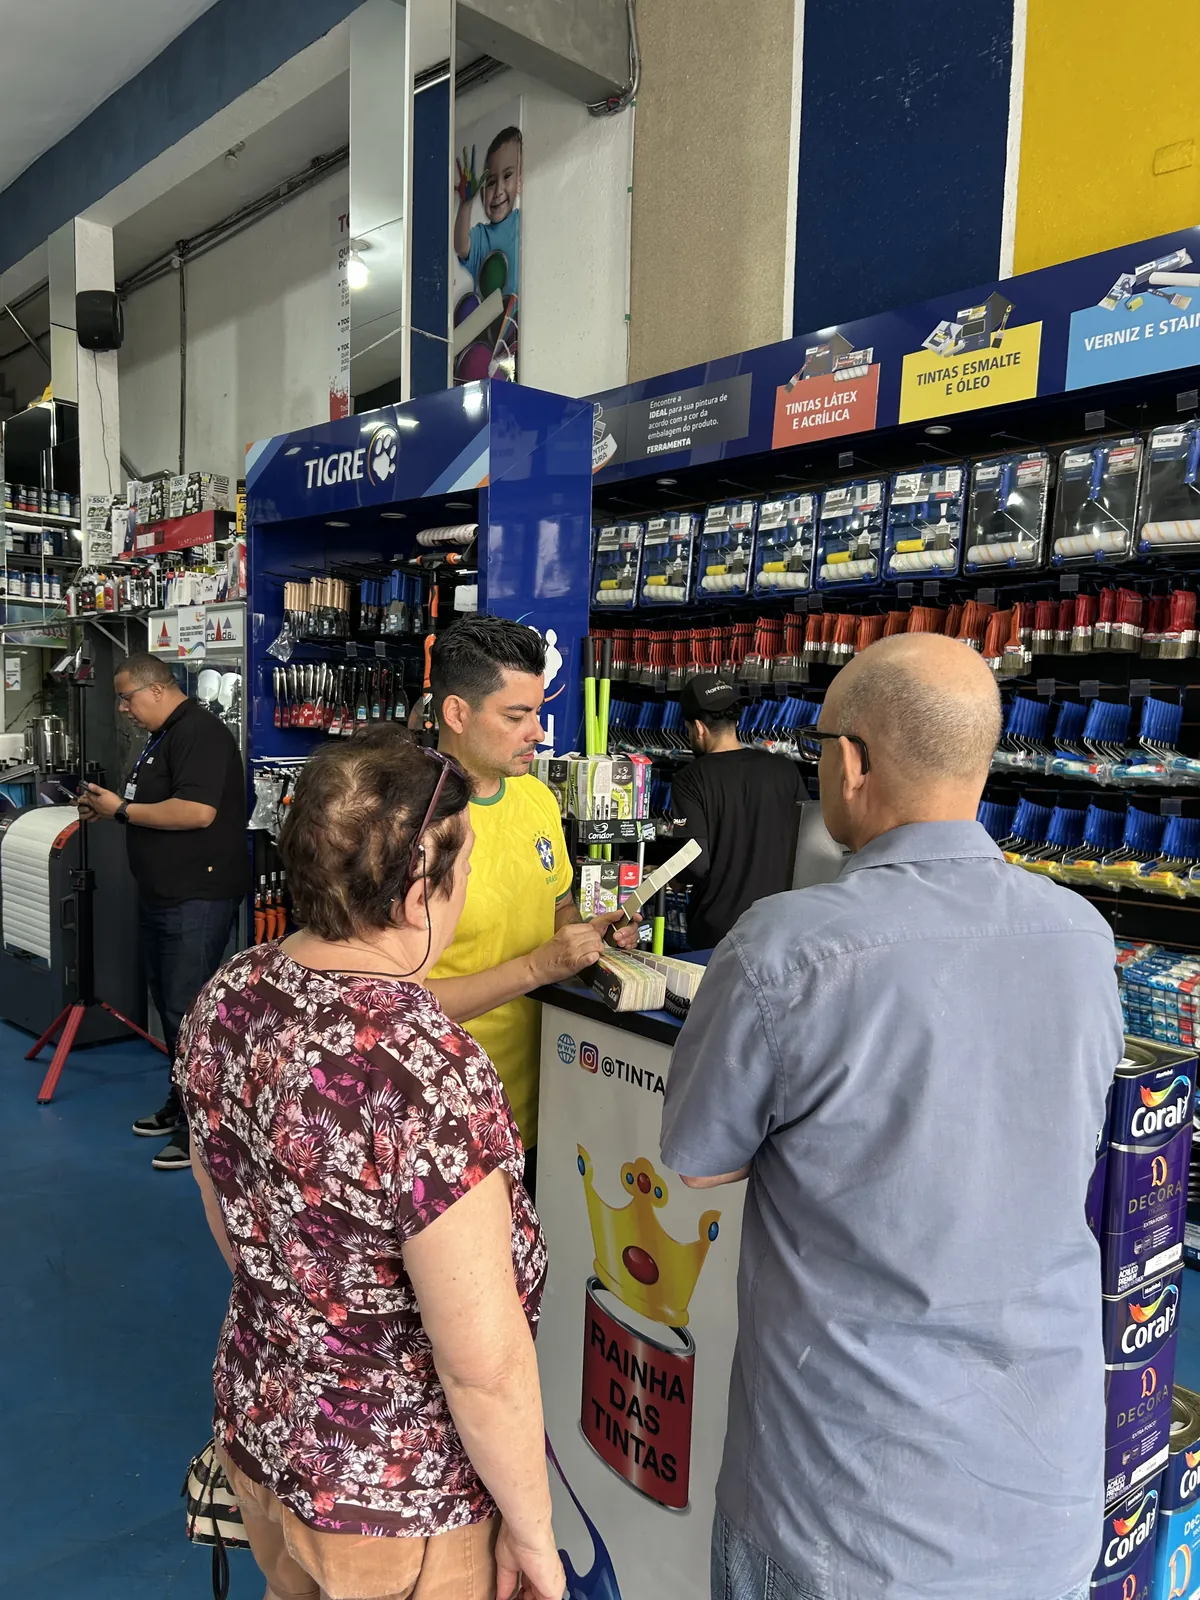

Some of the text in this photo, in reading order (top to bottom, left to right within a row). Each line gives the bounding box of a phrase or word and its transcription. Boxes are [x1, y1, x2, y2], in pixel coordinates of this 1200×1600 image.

[1084, 326, 1140, 351] VERNIZ
[1144, 323, 1154, 338] E
[916, 352, 1020, 386] TINTAS ESMALTE
[946, 375, 990, 396] E ÓLEO
[649, 393, 728, 419] IDEAL para sua pintura de
[650, 396, 676, 408] Encontre
[786, 390, 858, 416] TINTAS LÁTEX
[648, 418, 668, 430] acordo
[670, 416, 682, 424] com
[688, 412, 699, 420] cor
[700, 409, 708, 417] da
[648, 418, 719, 440] embalagem do produto.
[792, 408, 850, 430] E ACRÍLICA
[593, 442, 608, 454] NTAS
[646, 437, 692, 454] FERRAMENTA
[304, 448, 366, 488] TIGRE
[602, 1056, 666, 1096] @TINTA
[1131, 1098, 1182, 1138] Coral
[1128, 1182, 1182, 1214] DECORA
[1121, 1306, 1170, 1354] Coral
[590, 1319, 686, 1404] RAINHA
[609, 1378, 660, 1436] DAS
[1116, 1384, 1169, 1428] DECORA
[592, 1396, 677, 1483] TINTAS
[1104, 1512, 1150, 1568] Coral
